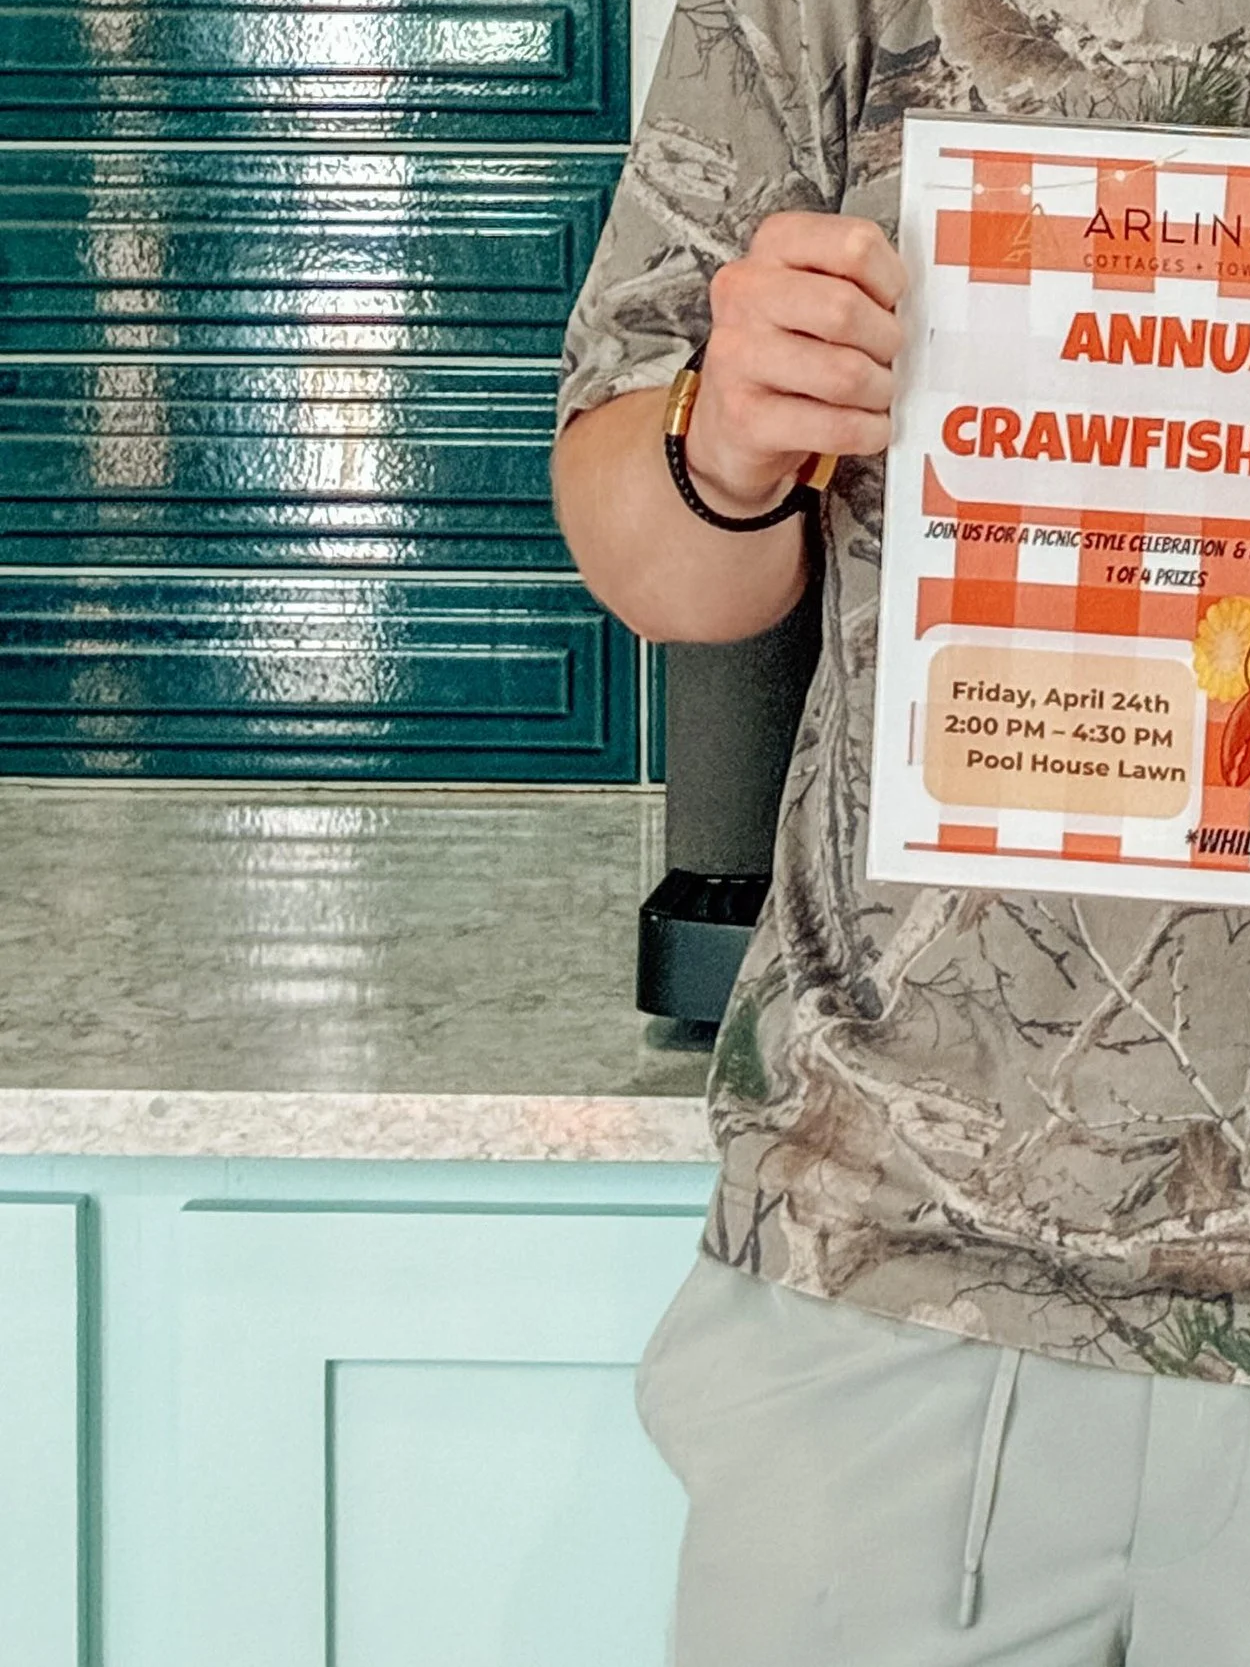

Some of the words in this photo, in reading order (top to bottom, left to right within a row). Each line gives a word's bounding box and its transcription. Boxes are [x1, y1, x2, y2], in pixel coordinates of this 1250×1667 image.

[1083, 253, 1185, 273] COTTAGES
[924, 521, 959, 539] JOIN
[962, 523, 983, 541] US
[984, 525, 1017, 544] FOR
[1018, 528, 1029, 544] A
[1031, 529, 1082, 548] PICNIC
[1083, 532, 1125, 551] STYLE
[1128, 534, 1227, 557] CELEBRATION
[1233, 541, 1247, 559] &
[1105, 566, 1113, 583] 1
[1116, 566, 1140, 584] OF
[1140, 568, 1152, 584] 4
[1154, 568, 1208, 588] PRIZES
[952, 680, 1036, 709] Friday,
[1043, 687, 1104, 711] April
[1111, 692, 1170, 714] 24th
[944, 714, 998, 735] 2:00
[1006, 718, 1045, 739] PM
[1071, 723, 1126, 745] 4:30
[1133, 727, 1173, 748] PM
[966, 749, 1023, 771] Pool
[1031, 754, 1110, 777] House
[1118, 760, 1187, 782] Lawn
